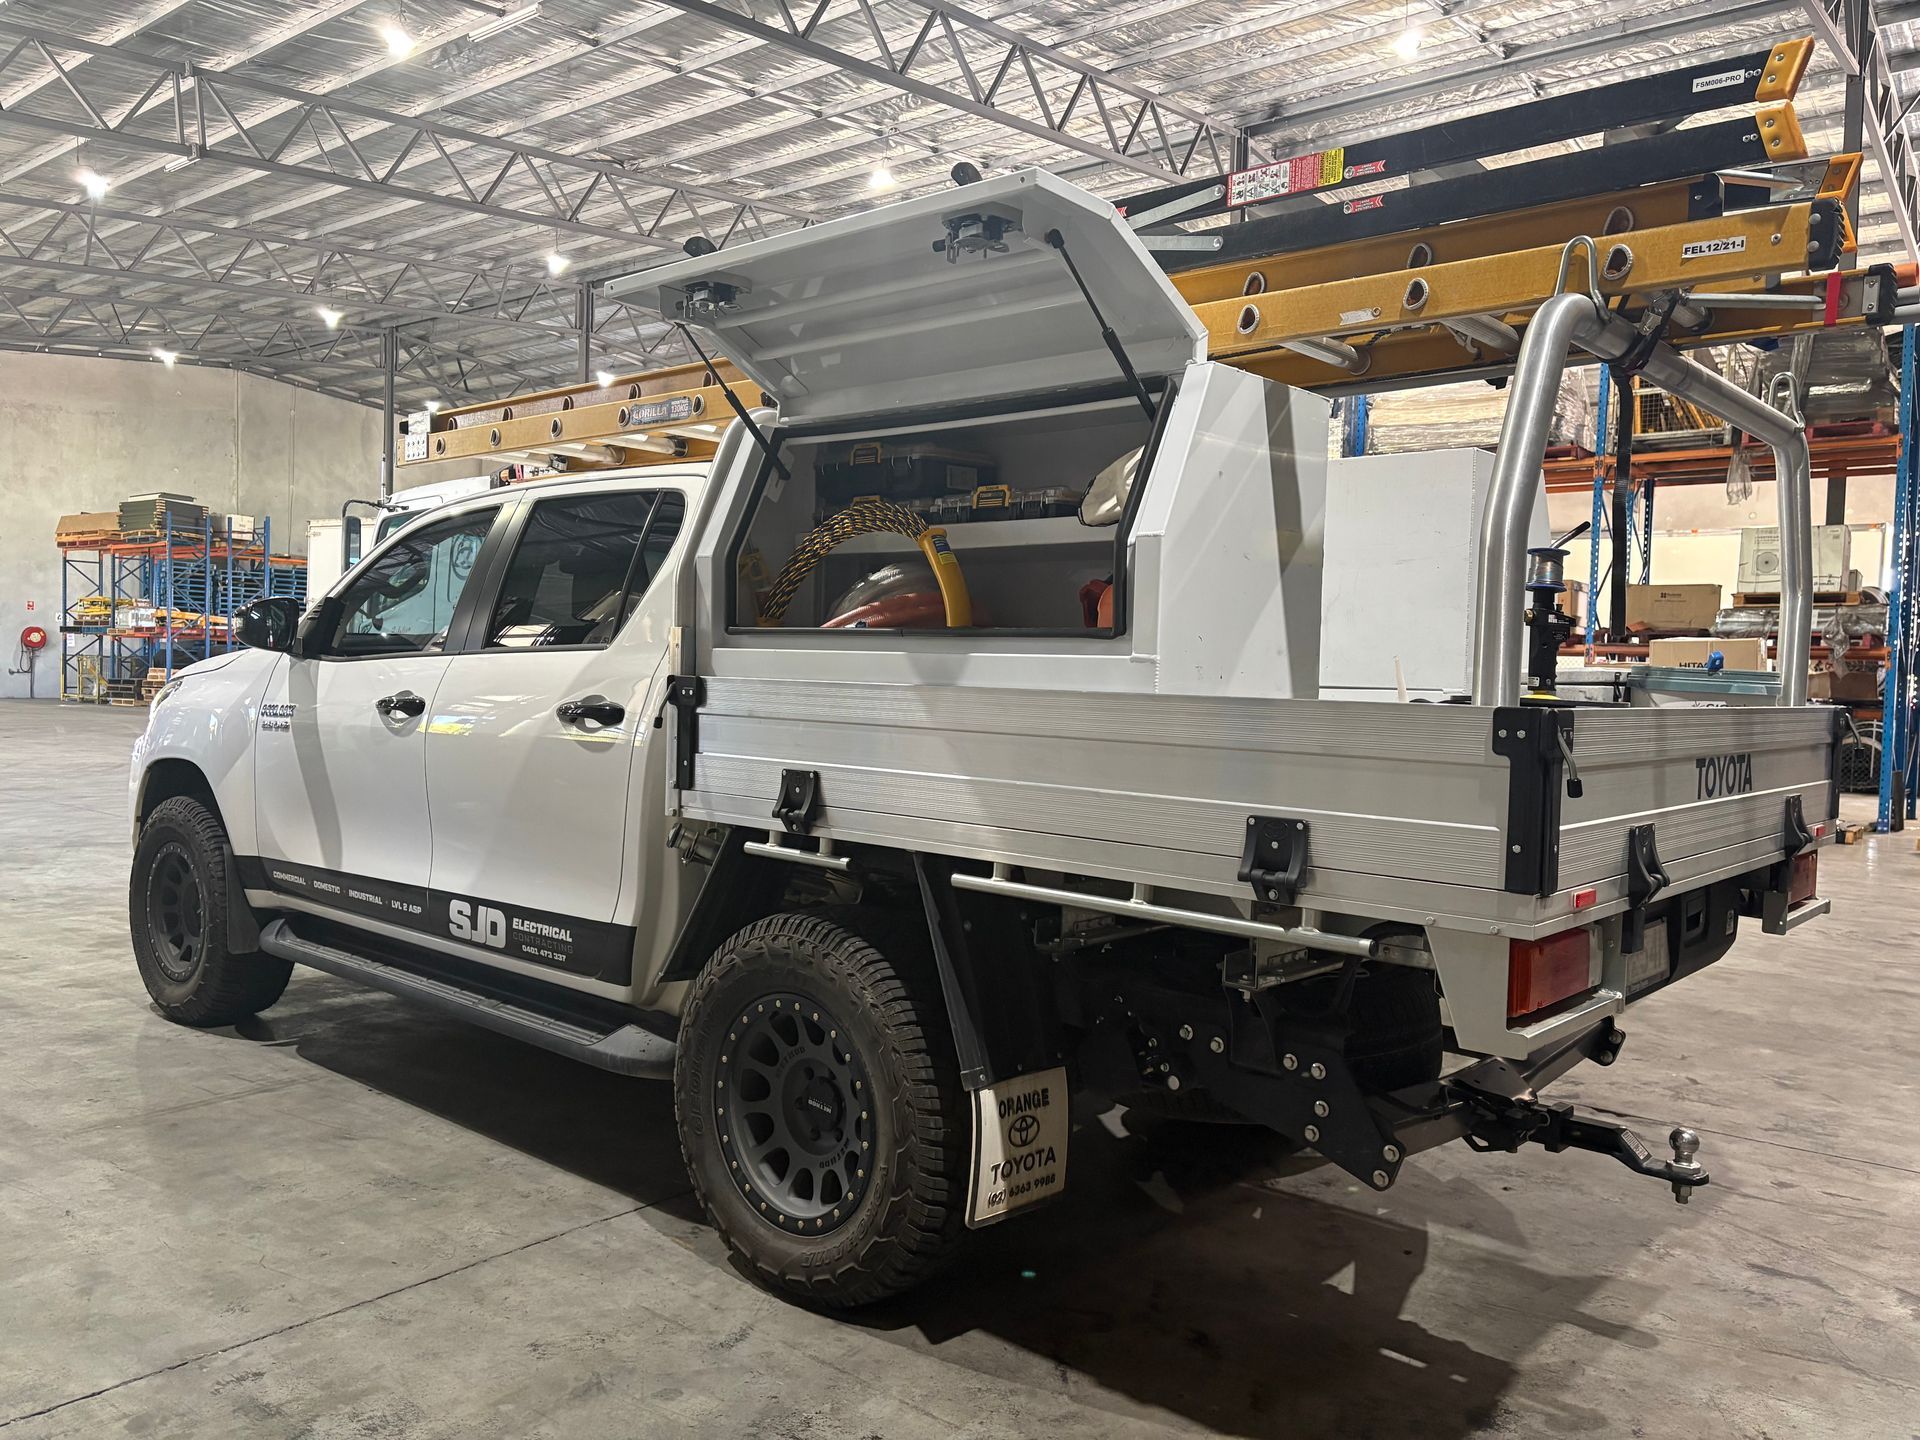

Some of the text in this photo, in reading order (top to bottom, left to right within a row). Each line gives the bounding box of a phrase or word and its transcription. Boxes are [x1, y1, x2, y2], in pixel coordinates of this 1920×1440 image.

[1695, 74, 1742, 89] FSM006-PRO
[1684, 240, 1744, 255] FEL12/21-I
[633, 407, 667, 419] GORILLA
[1696, 753, 1752, 800] TOYOTA
[273, 871, 422, 914] COMMERCIAL DOMESTIC INDUSTRIAL LVL 2 ASP
[449, 899, 506, 949] SJD
[512, 917, 573, 942] ELECTRICAL
[513, 931, 573, 954] CONTRACTING
[521, 944, 567, 962] 0401 473 337
[998, 1088, 1050, 1119] ORANGE
[991, 1147, 1057, 1186] TOYOTA
